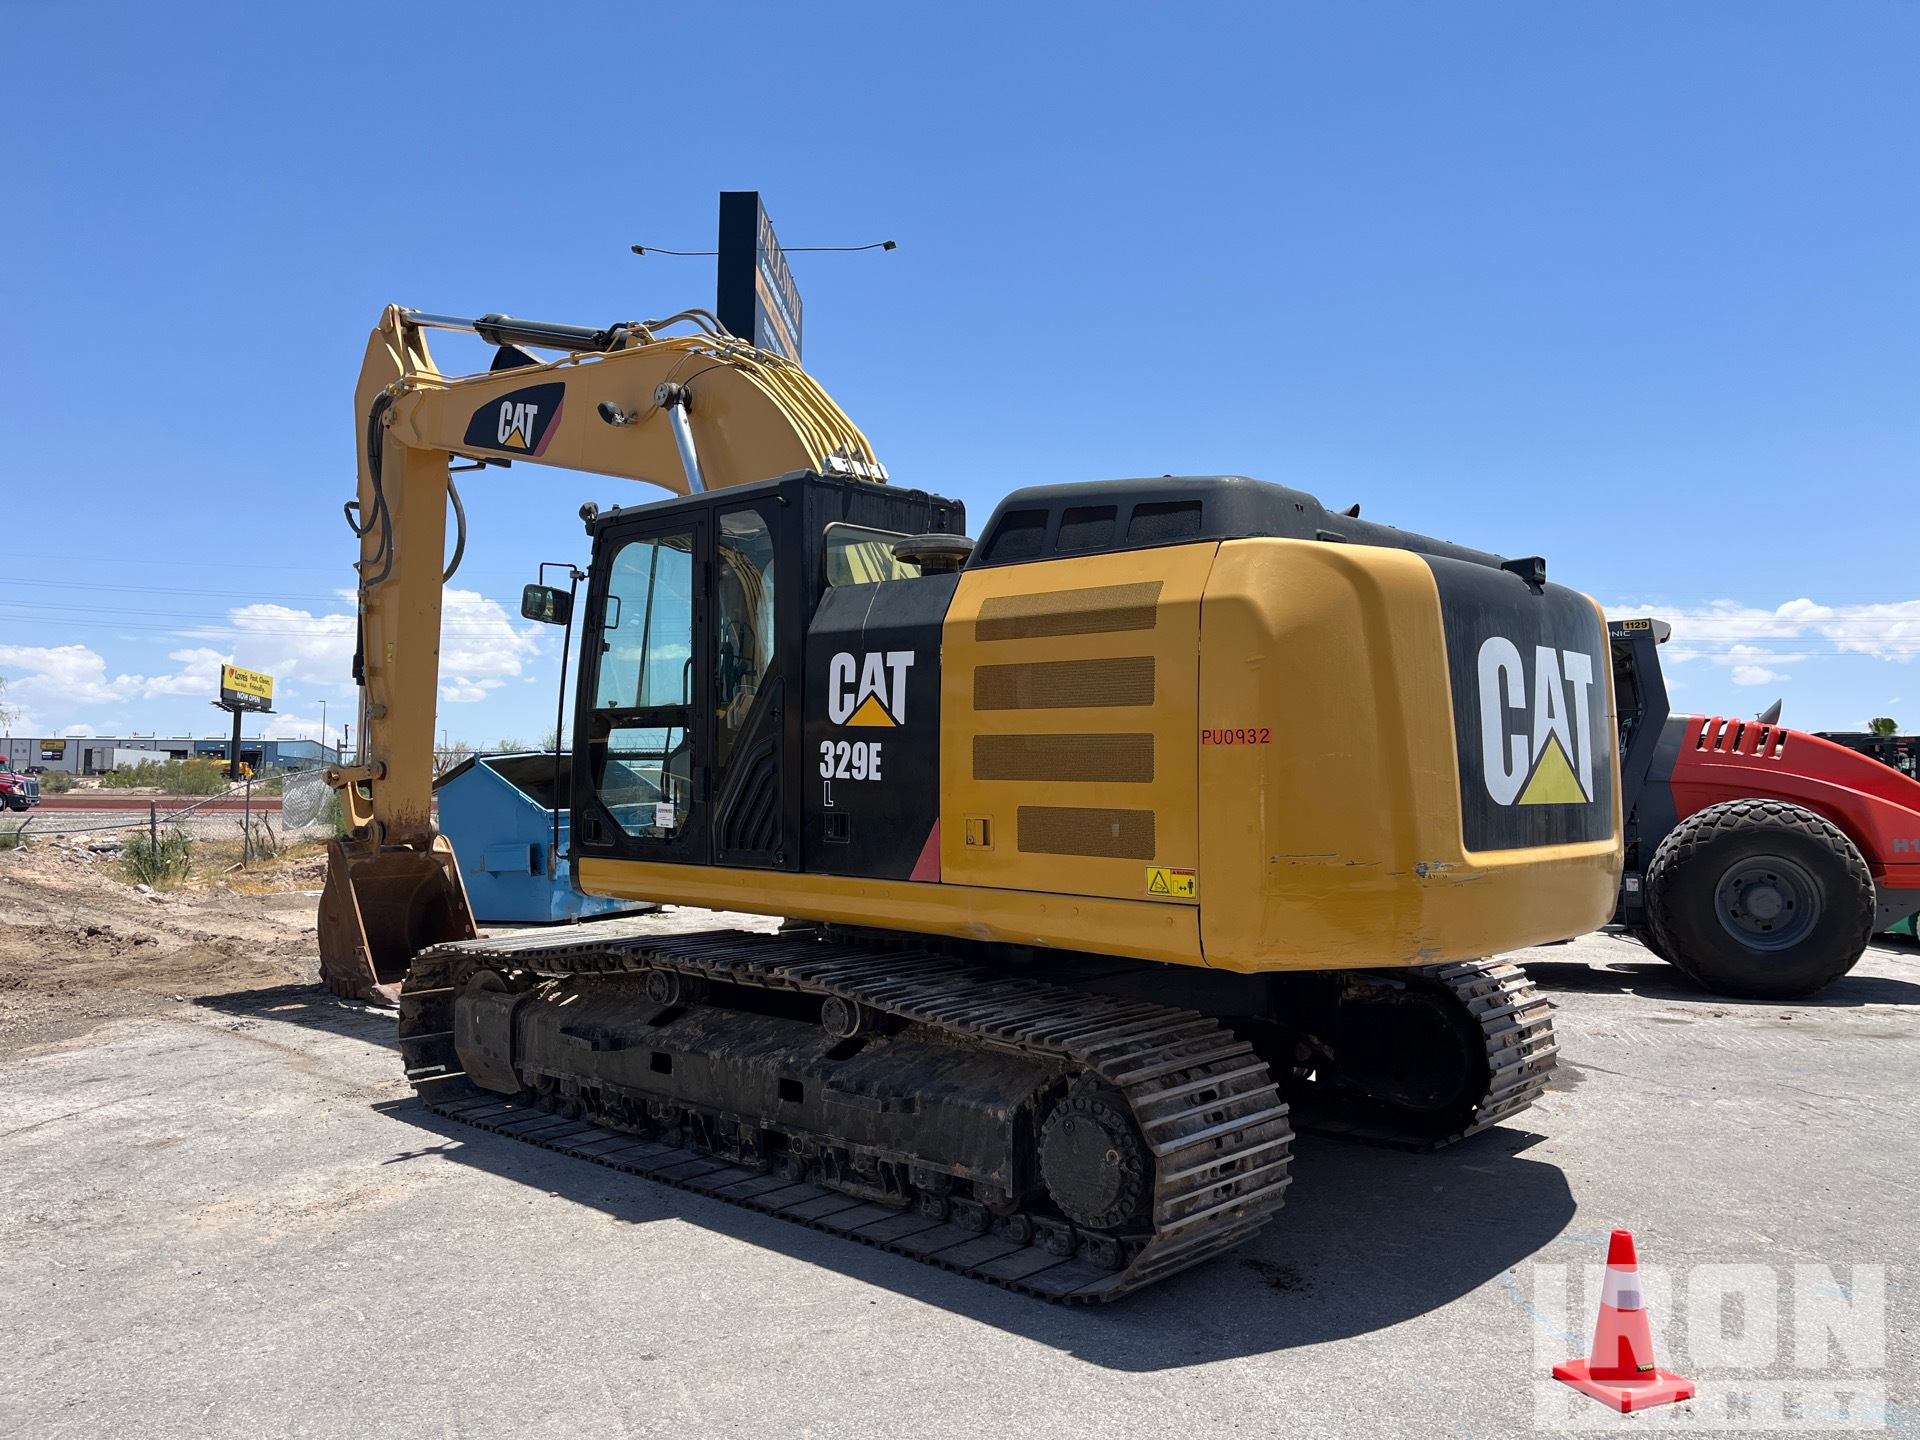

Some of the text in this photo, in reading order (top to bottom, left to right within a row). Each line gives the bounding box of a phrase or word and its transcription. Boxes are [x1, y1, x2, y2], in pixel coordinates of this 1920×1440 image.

[497, 400, 538, 448] CAT
[1625, 621, 1647, 629] 1129
[236, 691, 261, 704] NOW OPEN
[828, 651, 915, 726] CAT
[1202, 729, 1270, 745] PU0932
[1477, 636, 1594, 806] CAT
[819, 740, 882, 781] 329E
[823, 780, 834, 807] L
